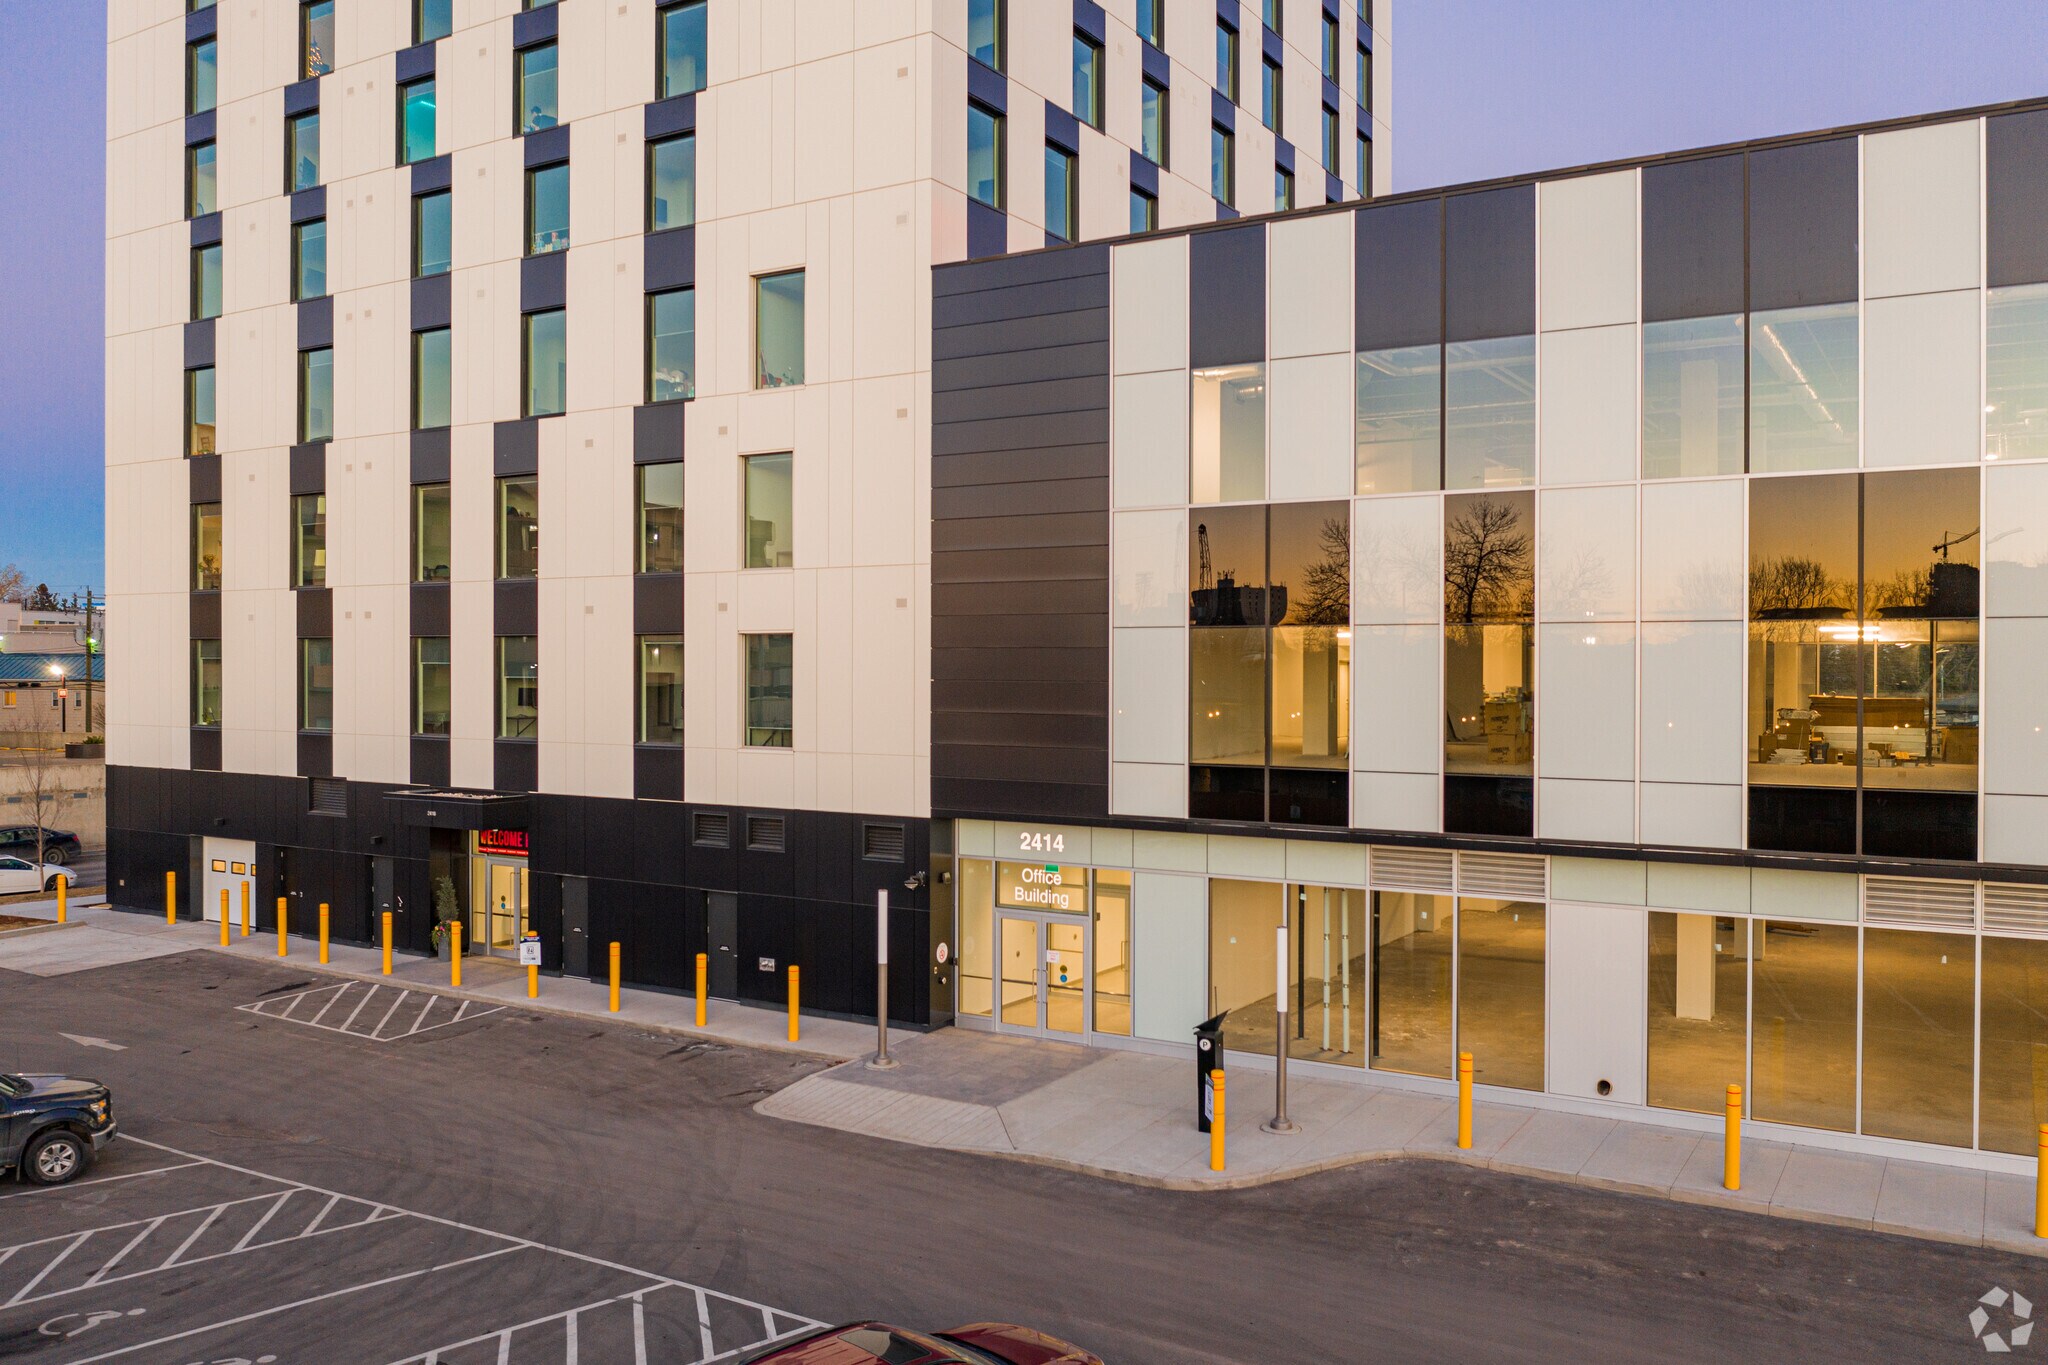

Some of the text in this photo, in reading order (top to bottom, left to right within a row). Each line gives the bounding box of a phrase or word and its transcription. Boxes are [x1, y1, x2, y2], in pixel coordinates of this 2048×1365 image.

[480, 829, 523, 847] WELCOME
[1020, 832, 1065, 852] 2414
[1021, 868, 1062, 886] Office
[1014, 886, 1069, 909] Building
